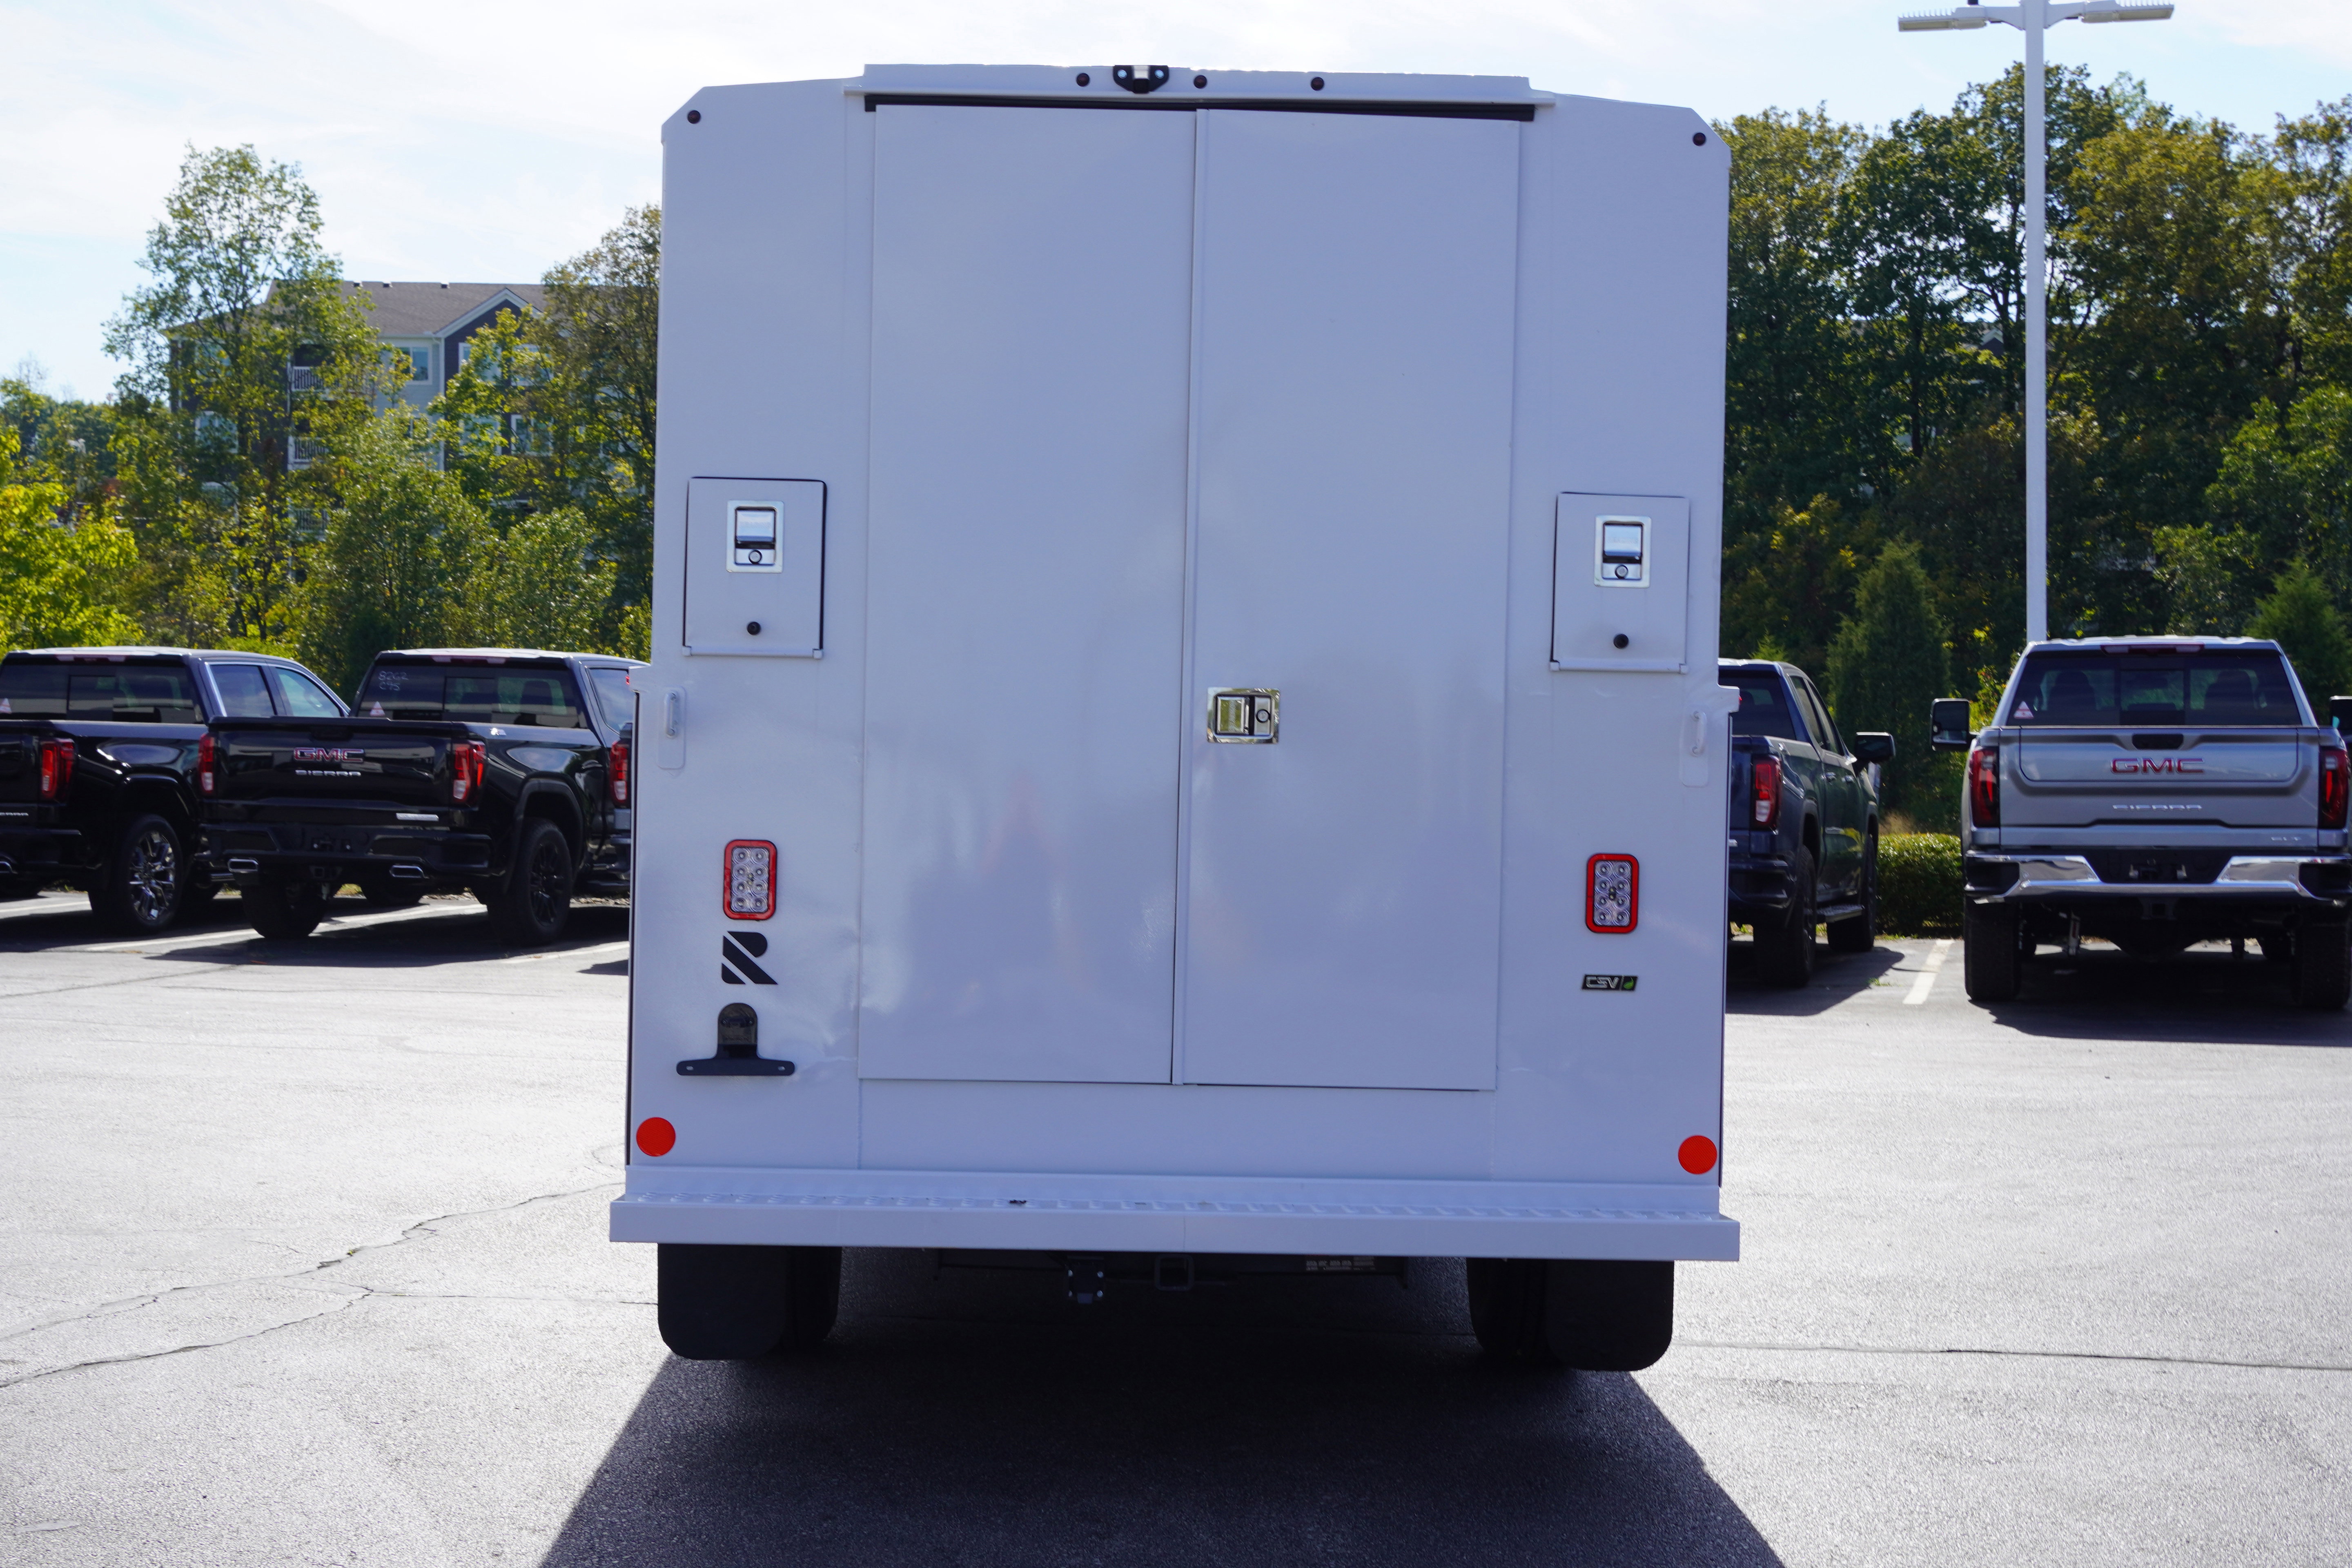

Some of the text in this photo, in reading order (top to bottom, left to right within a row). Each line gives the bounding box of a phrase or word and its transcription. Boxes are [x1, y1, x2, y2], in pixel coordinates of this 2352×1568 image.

[294, 747, 364, 762] GMC
[2110, 757, 2205, 775] GMC
[1586, 976, 1619, 989] CSV
